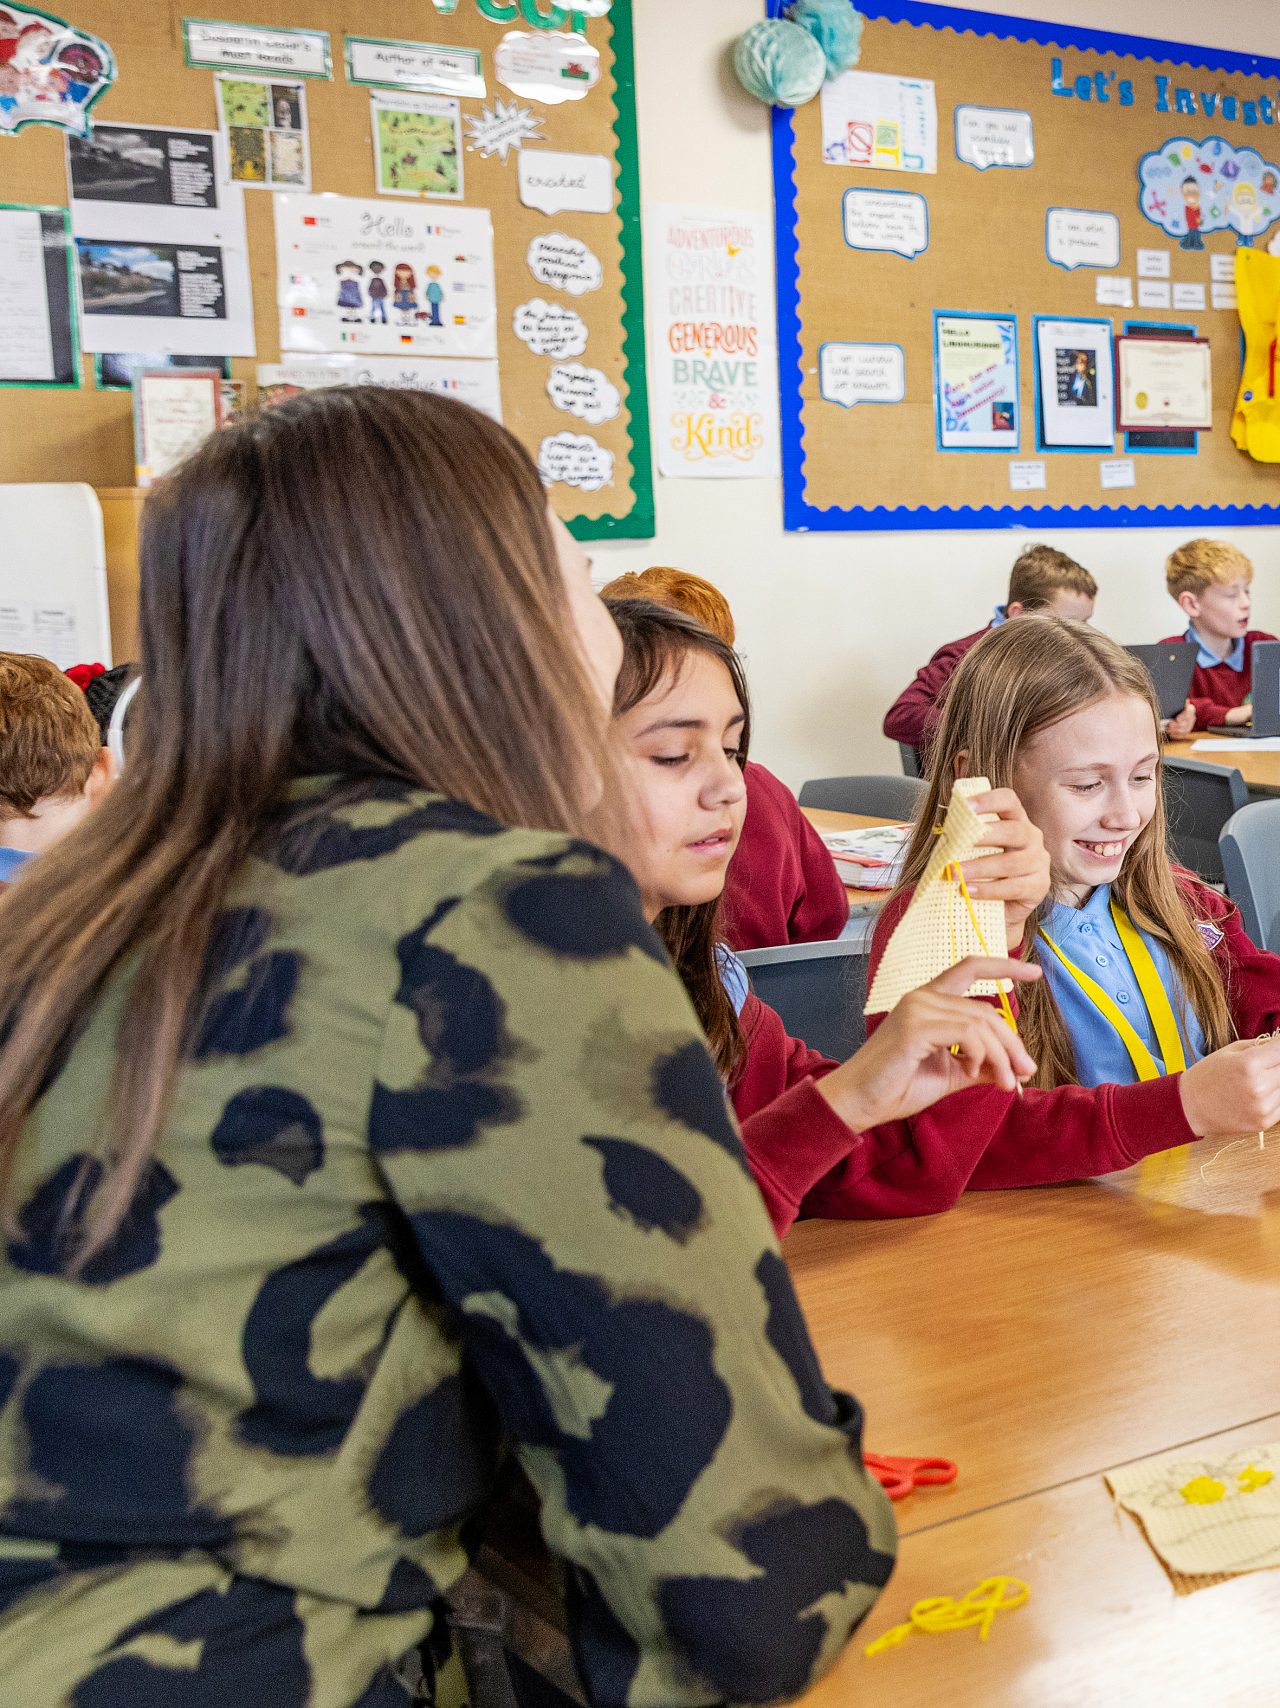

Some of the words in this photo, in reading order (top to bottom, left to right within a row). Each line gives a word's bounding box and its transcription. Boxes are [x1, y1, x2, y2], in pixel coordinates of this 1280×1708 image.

[1052, 57, 1134, 106] Let's
[361, 211, 414, 239] Hello
[666, 224, 754, 249] ADVENTUROUS
[669, 284, 759, 322] CREATIVE
[668, 322, 759, 357] GENEROUS
[672, 359, 759, 392] BRAVE
[708, 391, 728, 410] &
[680, 411, 756, 457] Kind
